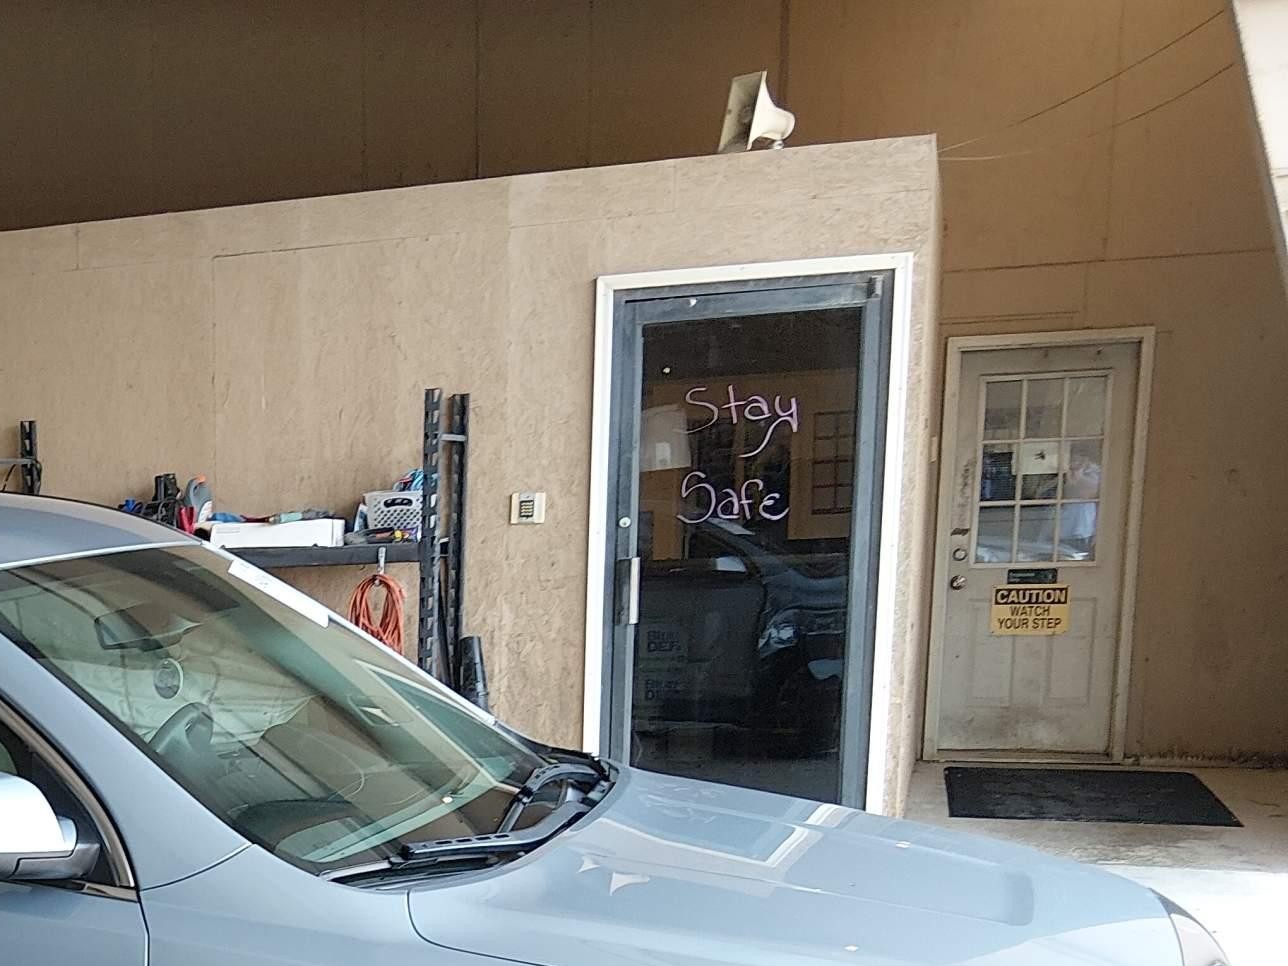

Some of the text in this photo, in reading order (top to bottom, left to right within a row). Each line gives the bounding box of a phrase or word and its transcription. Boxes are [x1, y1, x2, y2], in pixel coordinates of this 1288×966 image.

[674, 385, 798, 458] Stay
[676, 471, 790, 523] Safe
[996, 589, 1066, 604] CAUTION
[1010, 605, 1051, 617] WATCH
[998, 617, 1062, 630] YOUR STEP
